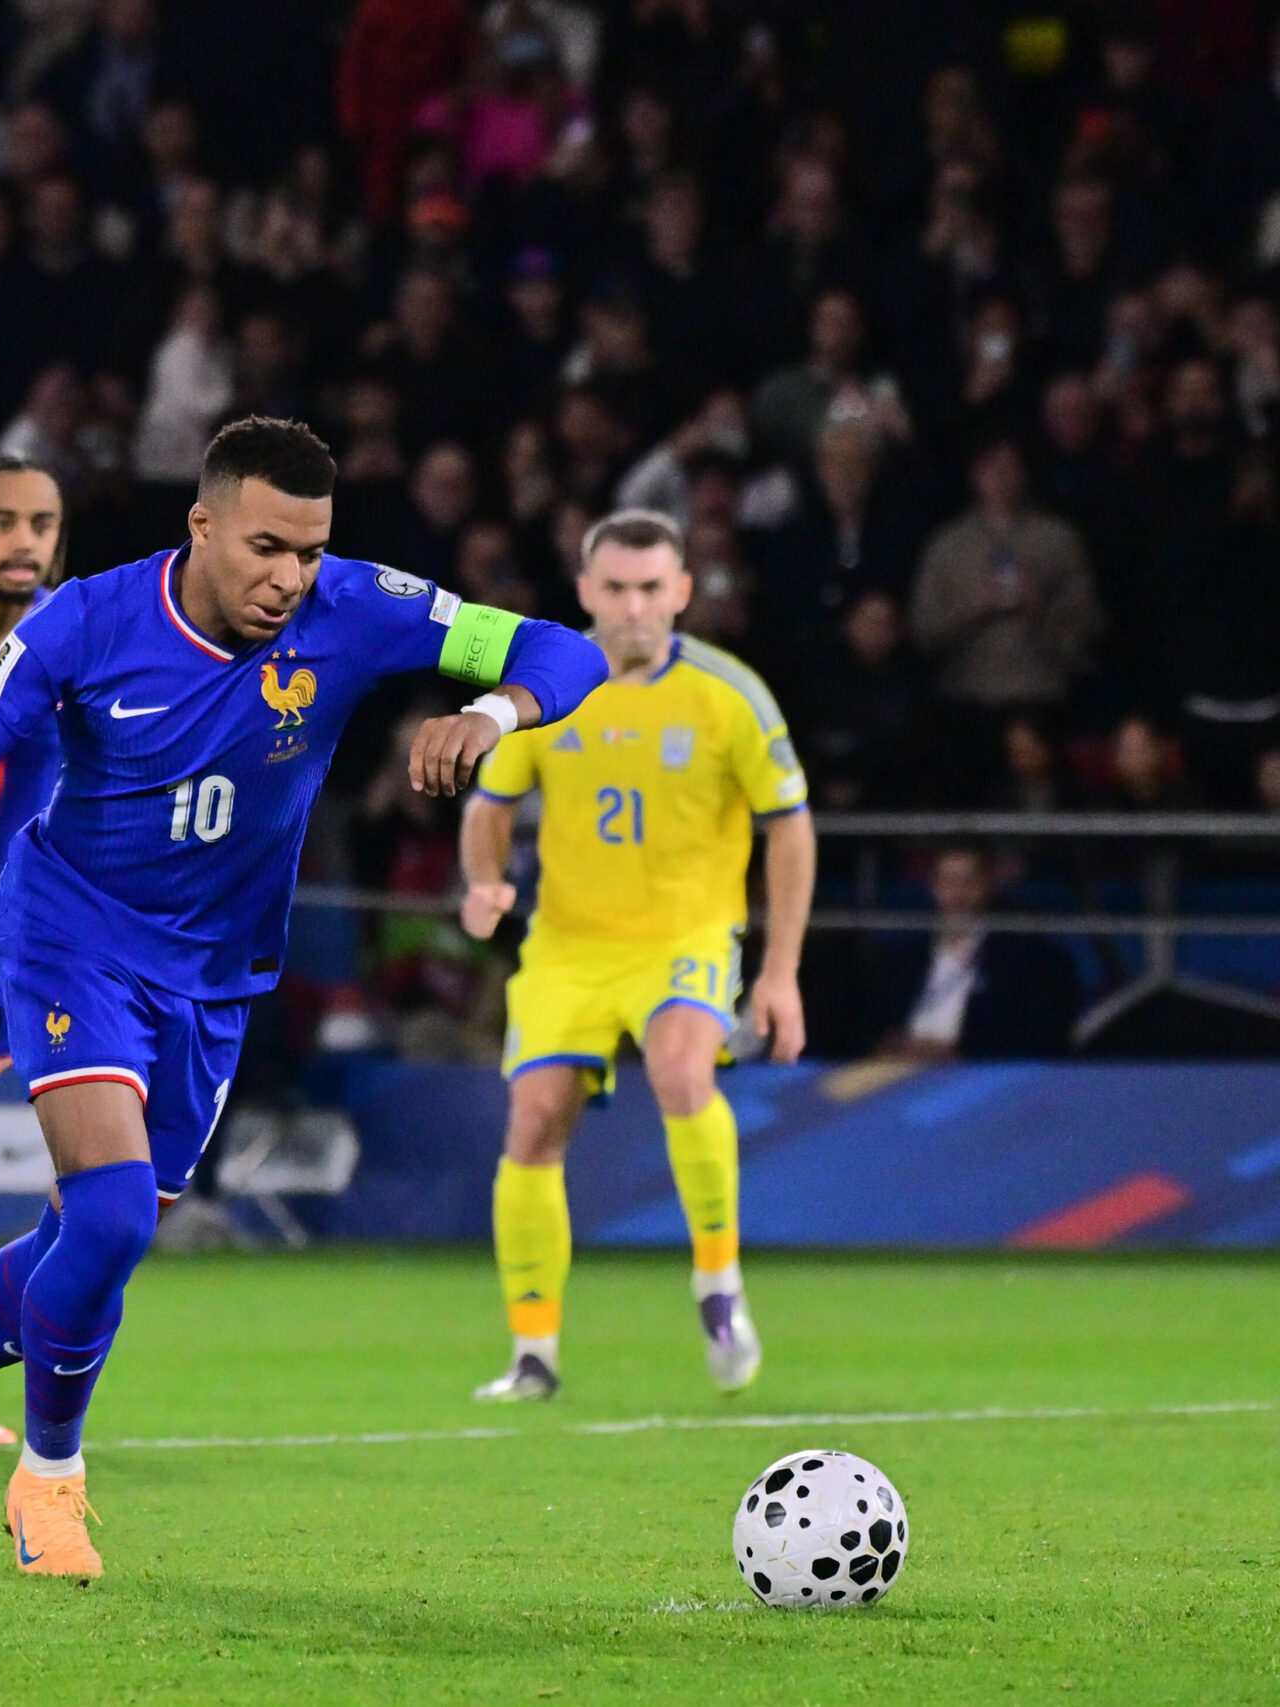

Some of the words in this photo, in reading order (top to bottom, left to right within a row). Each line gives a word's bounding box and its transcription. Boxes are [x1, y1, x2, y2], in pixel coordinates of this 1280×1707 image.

[464, 634, 484, 680] SPECT
[166, 775, 236, 842] 10
[597, 787, 644, 845] 21
[669, 957, 718, 995] 21
